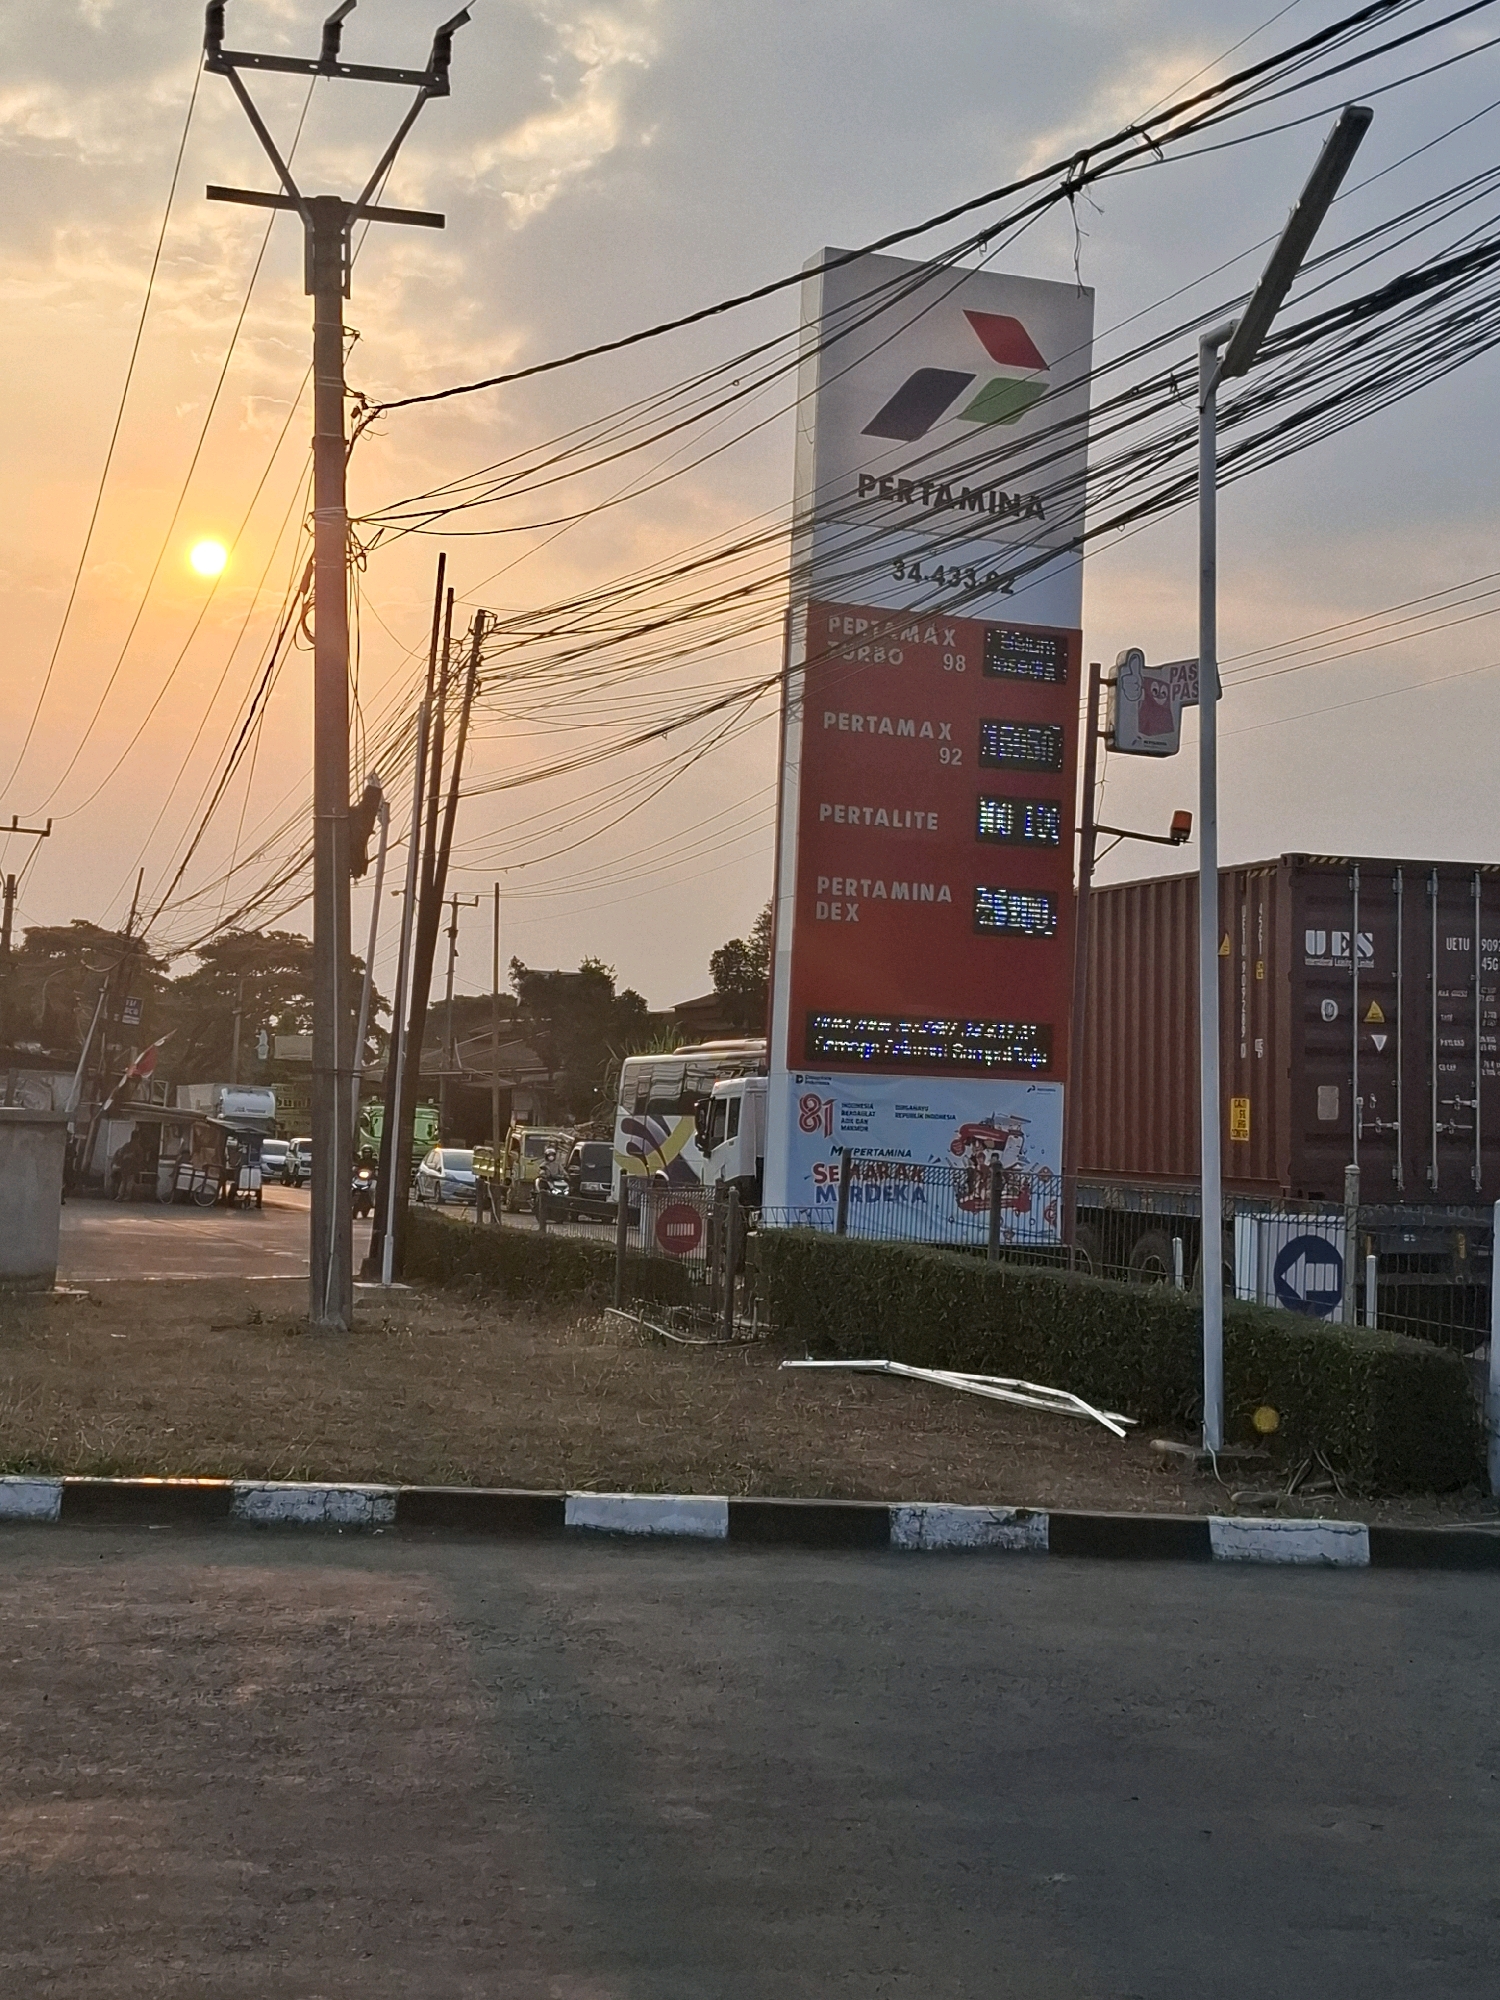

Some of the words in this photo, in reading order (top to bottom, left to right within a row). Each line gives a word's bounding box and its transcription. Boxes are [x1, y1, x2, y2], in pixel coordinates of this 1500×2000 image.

[858, 473, 1046, 520] PERTAMINA
[943, 653, 967, 672] 98
[823, 711, 952, 741] PERTAMAX
[939, 747, 963, 766] 92
[819, 803, 939, 831] PERTALITE
[817, 876, 952, 903] PERTAMINA
[815, 901, 860, 922] DEX
[1305, 929, 1374, 958] UES
[1446, 937, 1470, 951] UETU
[799, 1093, 838, 1139] 81
[830, 1145, 912, 1158] MPERTAMINA
[815, 1184, 926, 1204] MRDEKA
